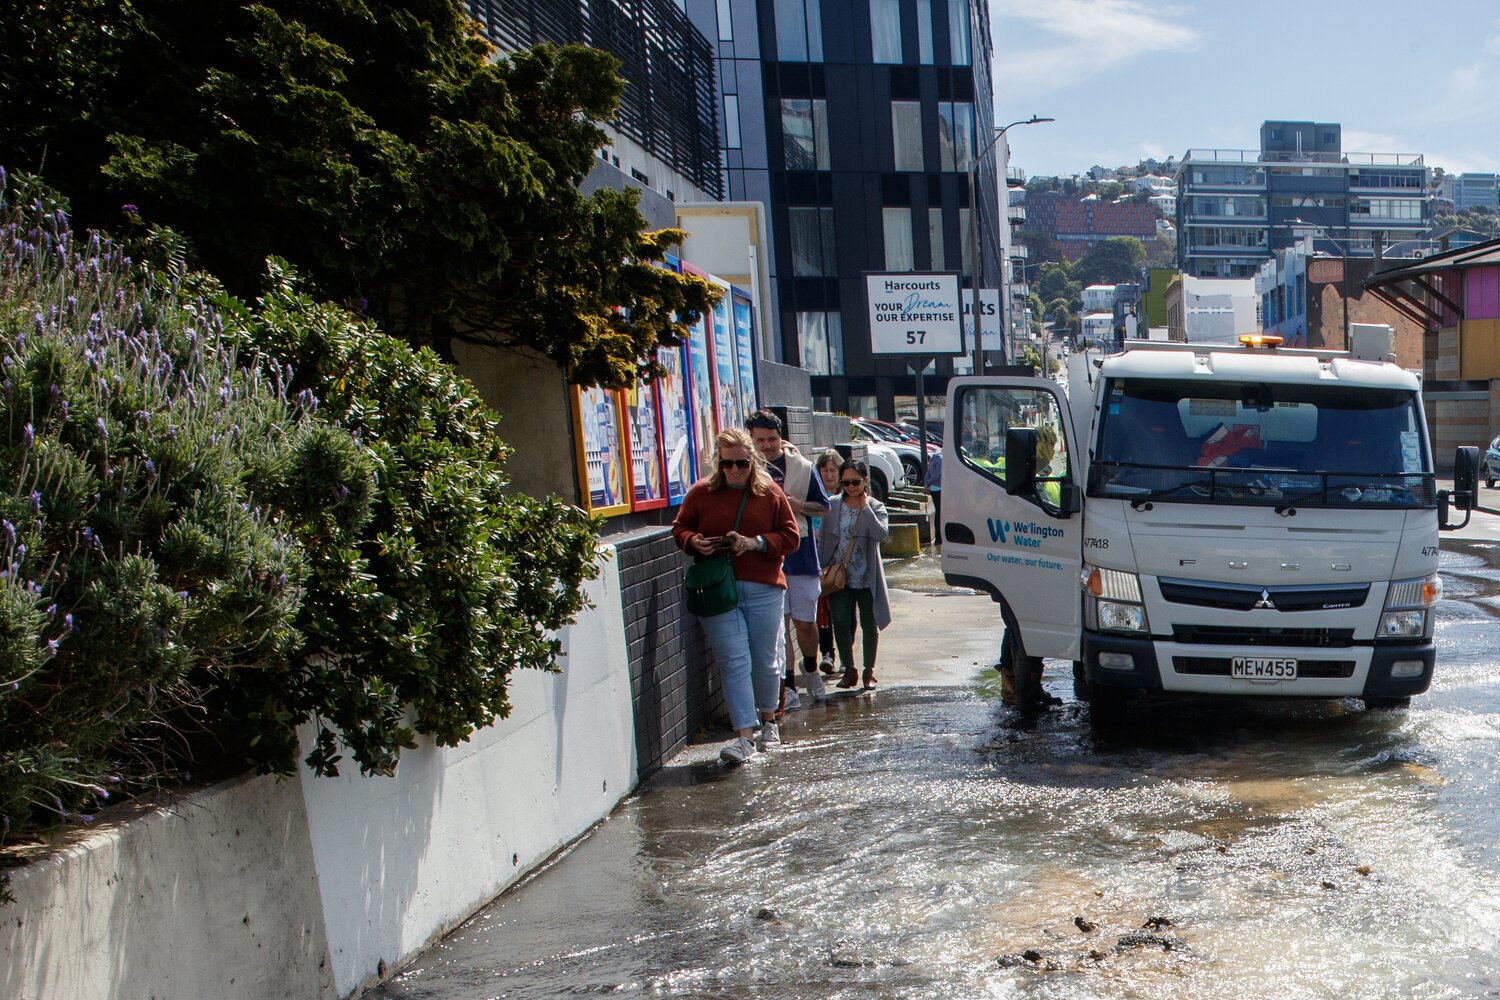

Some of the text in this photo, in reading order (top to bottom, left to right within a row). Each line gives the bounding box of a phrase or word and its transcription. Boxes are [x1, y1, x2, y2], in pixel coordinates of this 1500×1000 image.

[885, 280, 940, 291] Harcourts
[874, 302, 903, 312] YOUR
[902, 293, 952, 313] Dream
[876, 312, 954, 322] OUR EXPERTISE
[906, 330, 926, 345] 57
[1014, 522, 1064, 538] Welington
[1014, 535, 1041, 547] Water
[986, 552, 1064, 570] Our water, our future.
[1234, 660, 1295, 676] MEW455
